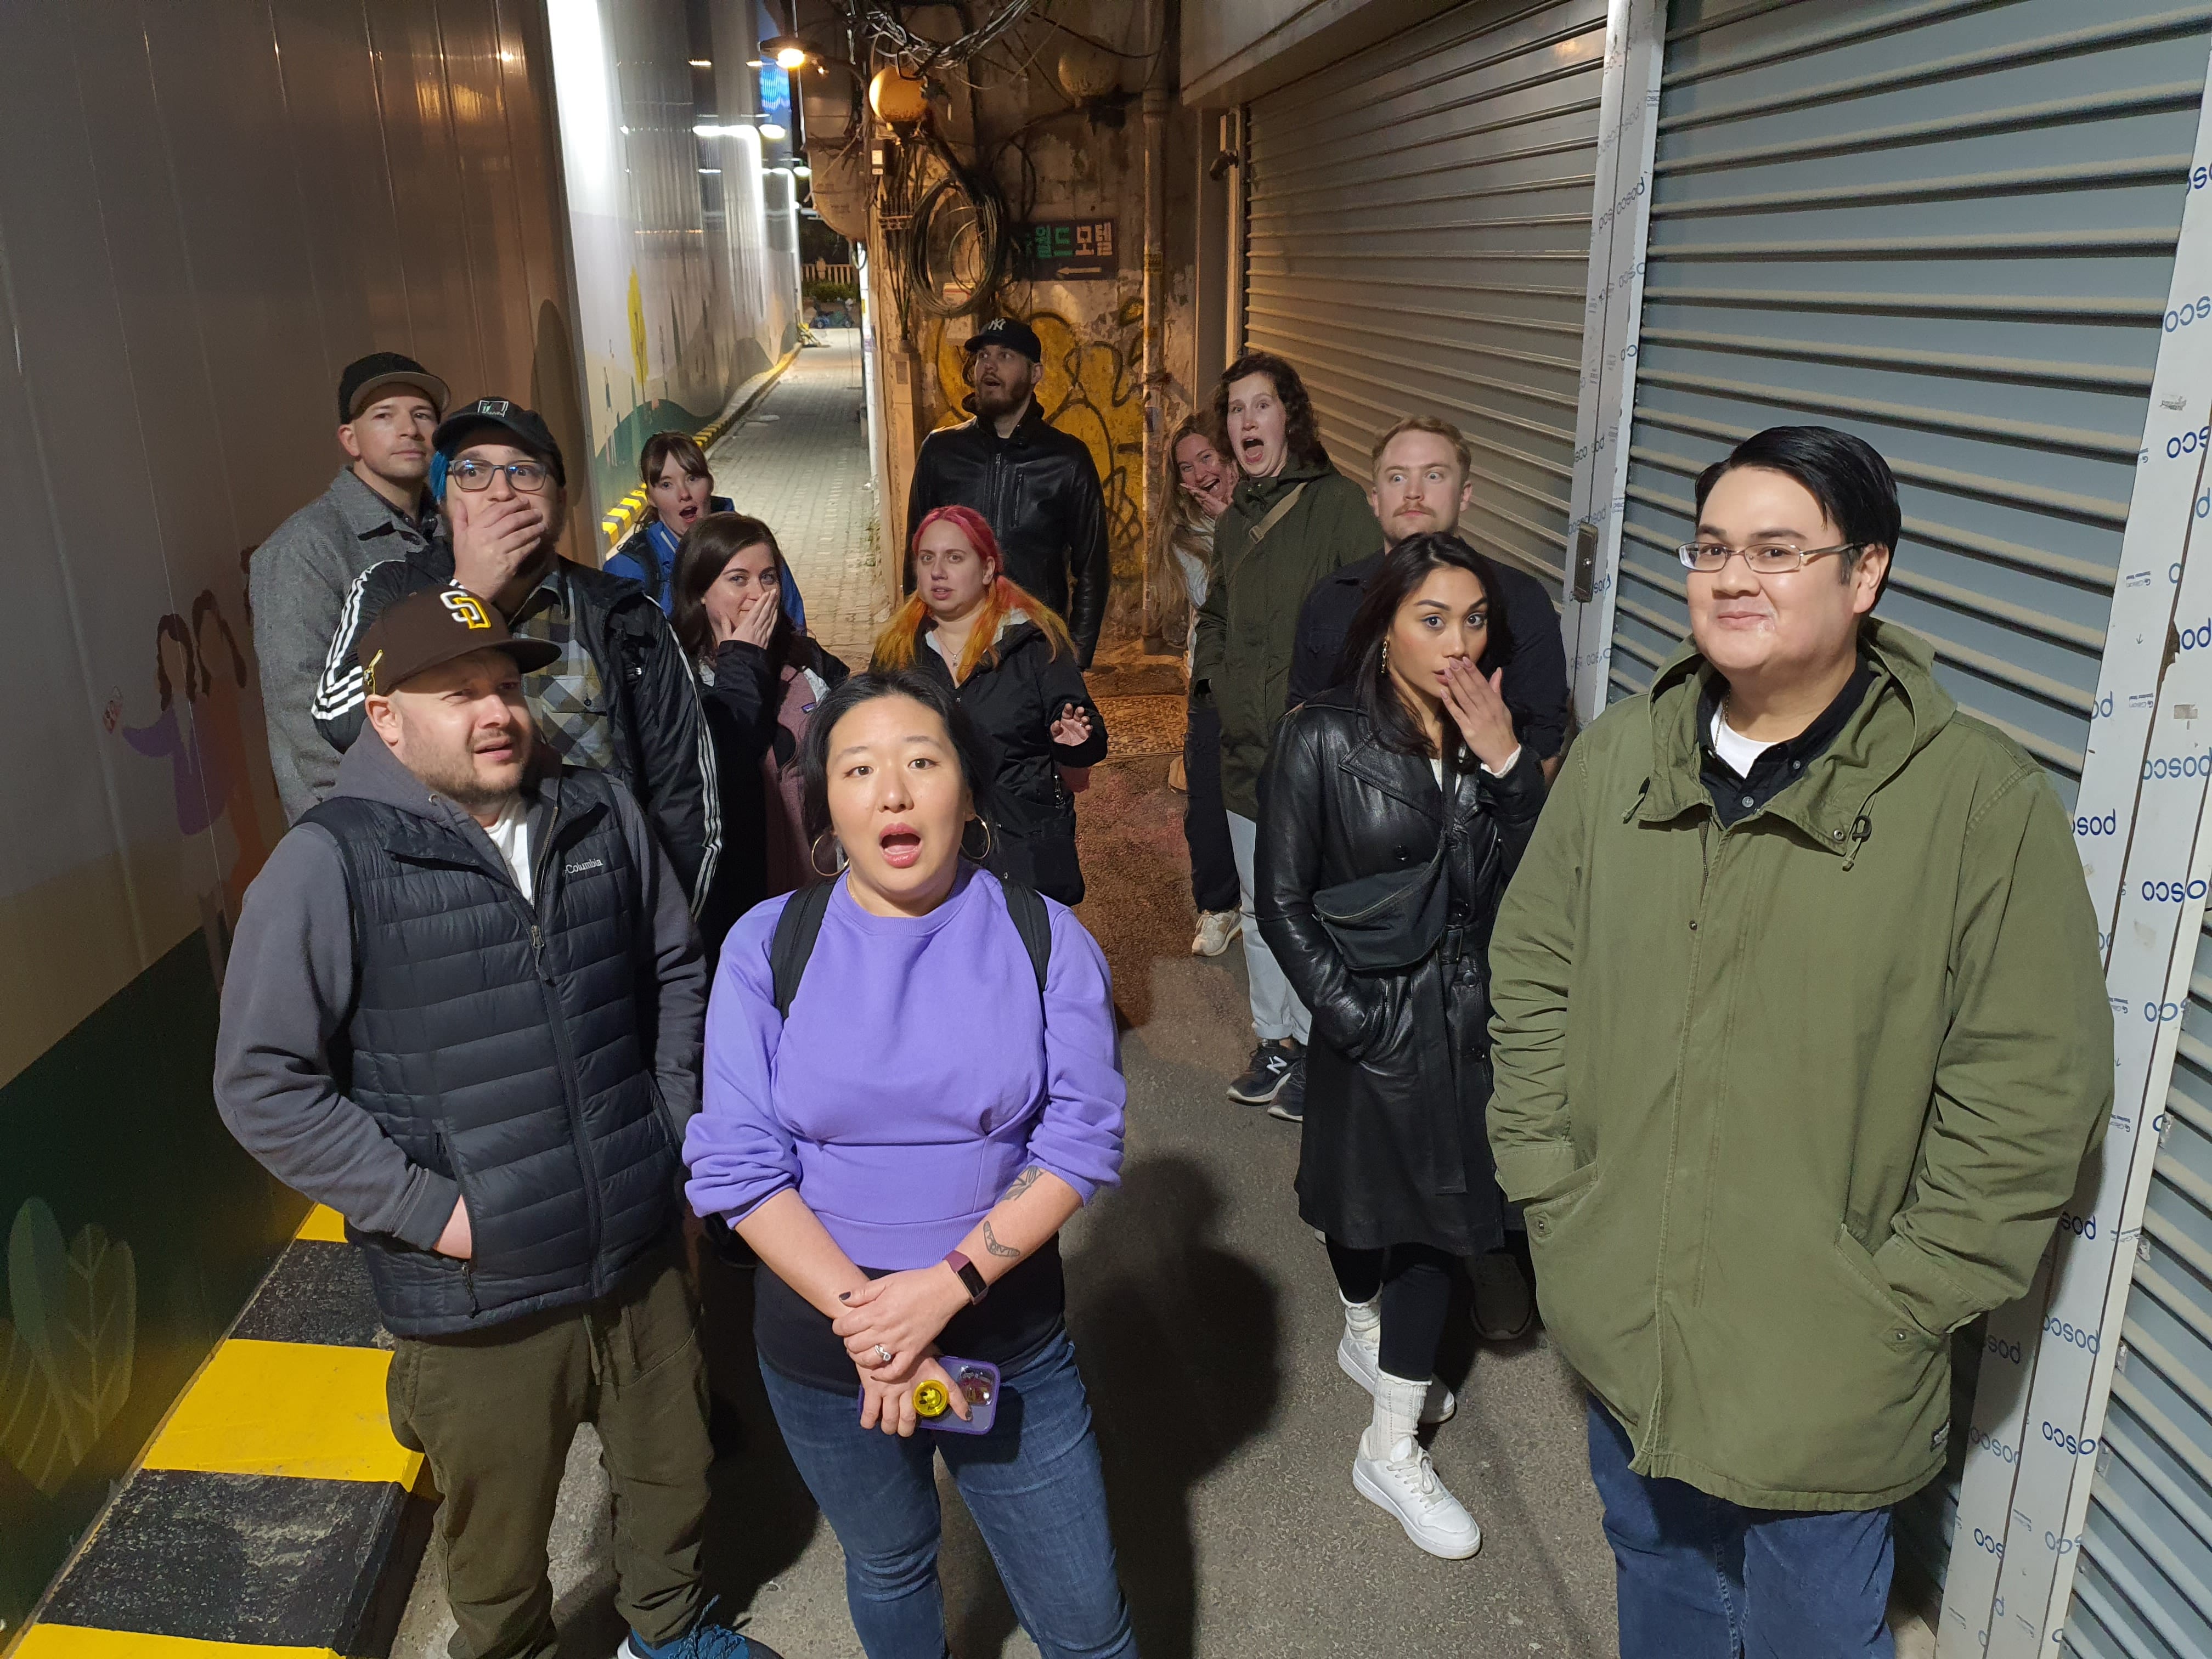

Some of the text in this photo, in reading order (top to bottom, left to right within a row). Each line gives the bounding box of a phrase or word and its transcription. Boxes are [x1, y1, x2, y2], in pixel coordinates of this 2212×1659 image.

[988, 318, 1006, 330] NY
[440, 590, 492, 629] SD
[566, 858, 603, 874] Columbia
[1266, 1056, 1287, 1075] N
